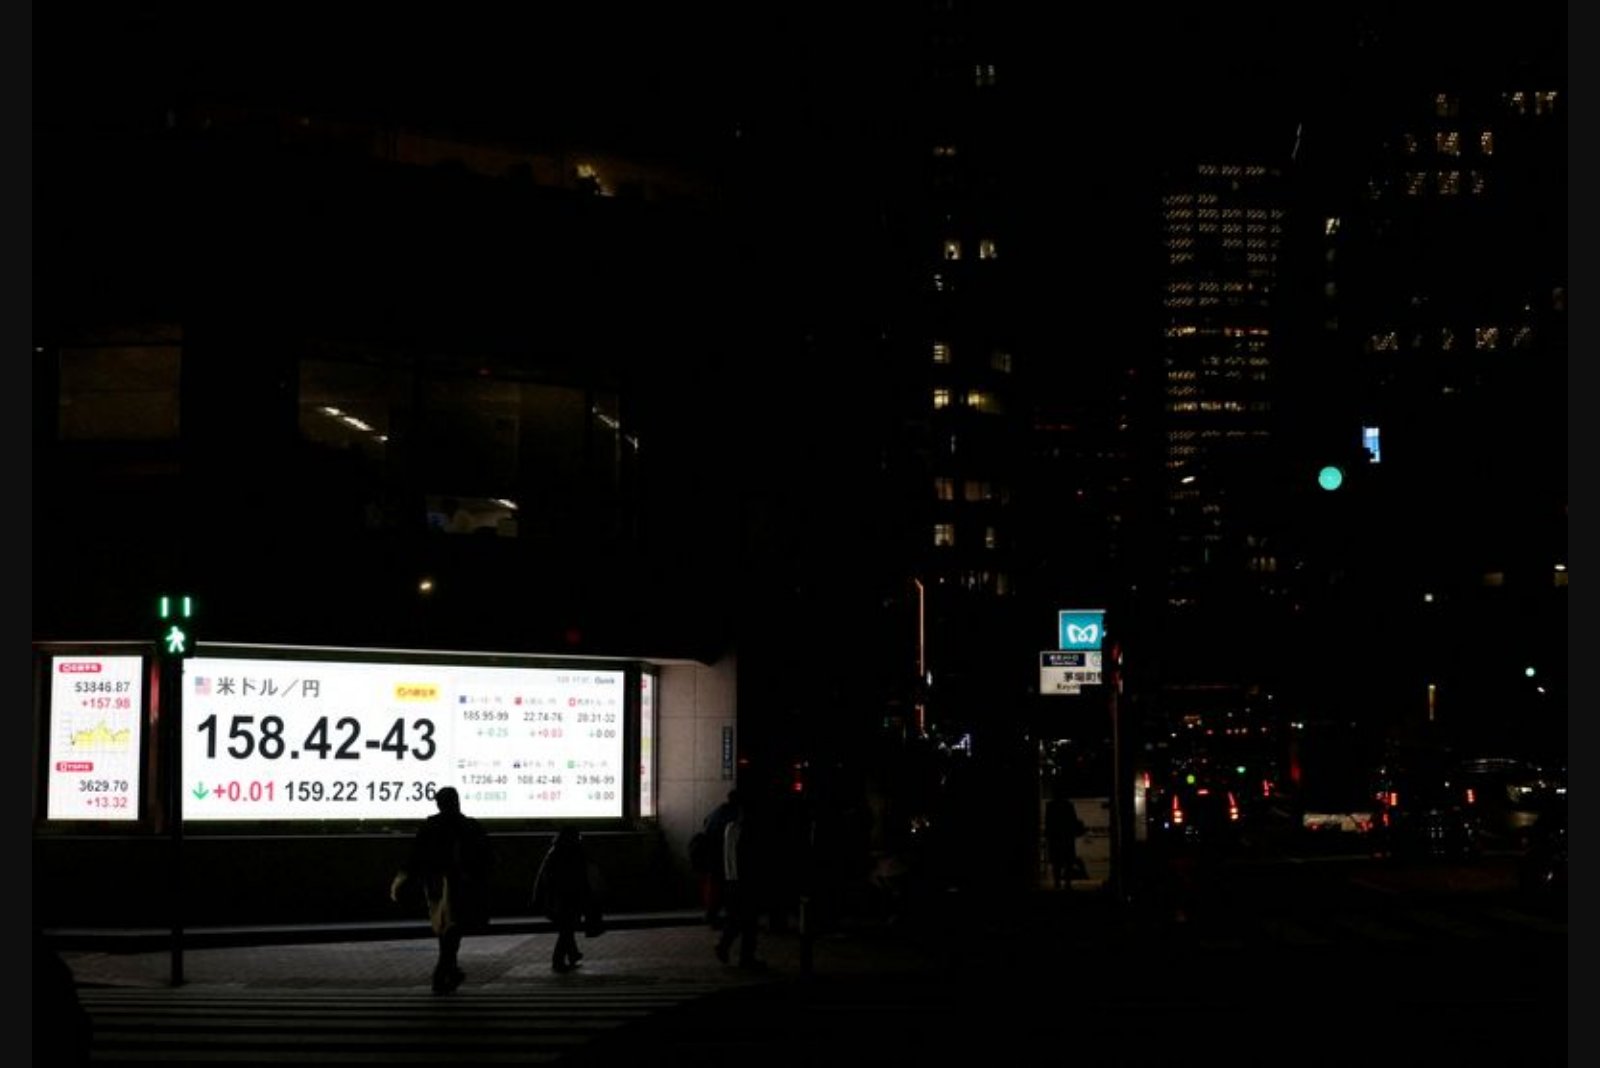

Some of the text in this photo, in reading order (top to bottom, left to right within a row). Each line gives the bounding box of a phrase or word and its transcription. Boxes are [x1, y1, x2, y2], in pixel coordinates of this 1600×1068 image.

[74, 681, 131, 693] 53846.87
[197, 713, 437, 761] 158.42-43
[79, 779, 129, 792] 3629.70
[213, 780, 437, 801] +0.01 159.22 157.36
[86, 797, 128, 808] +13.32
